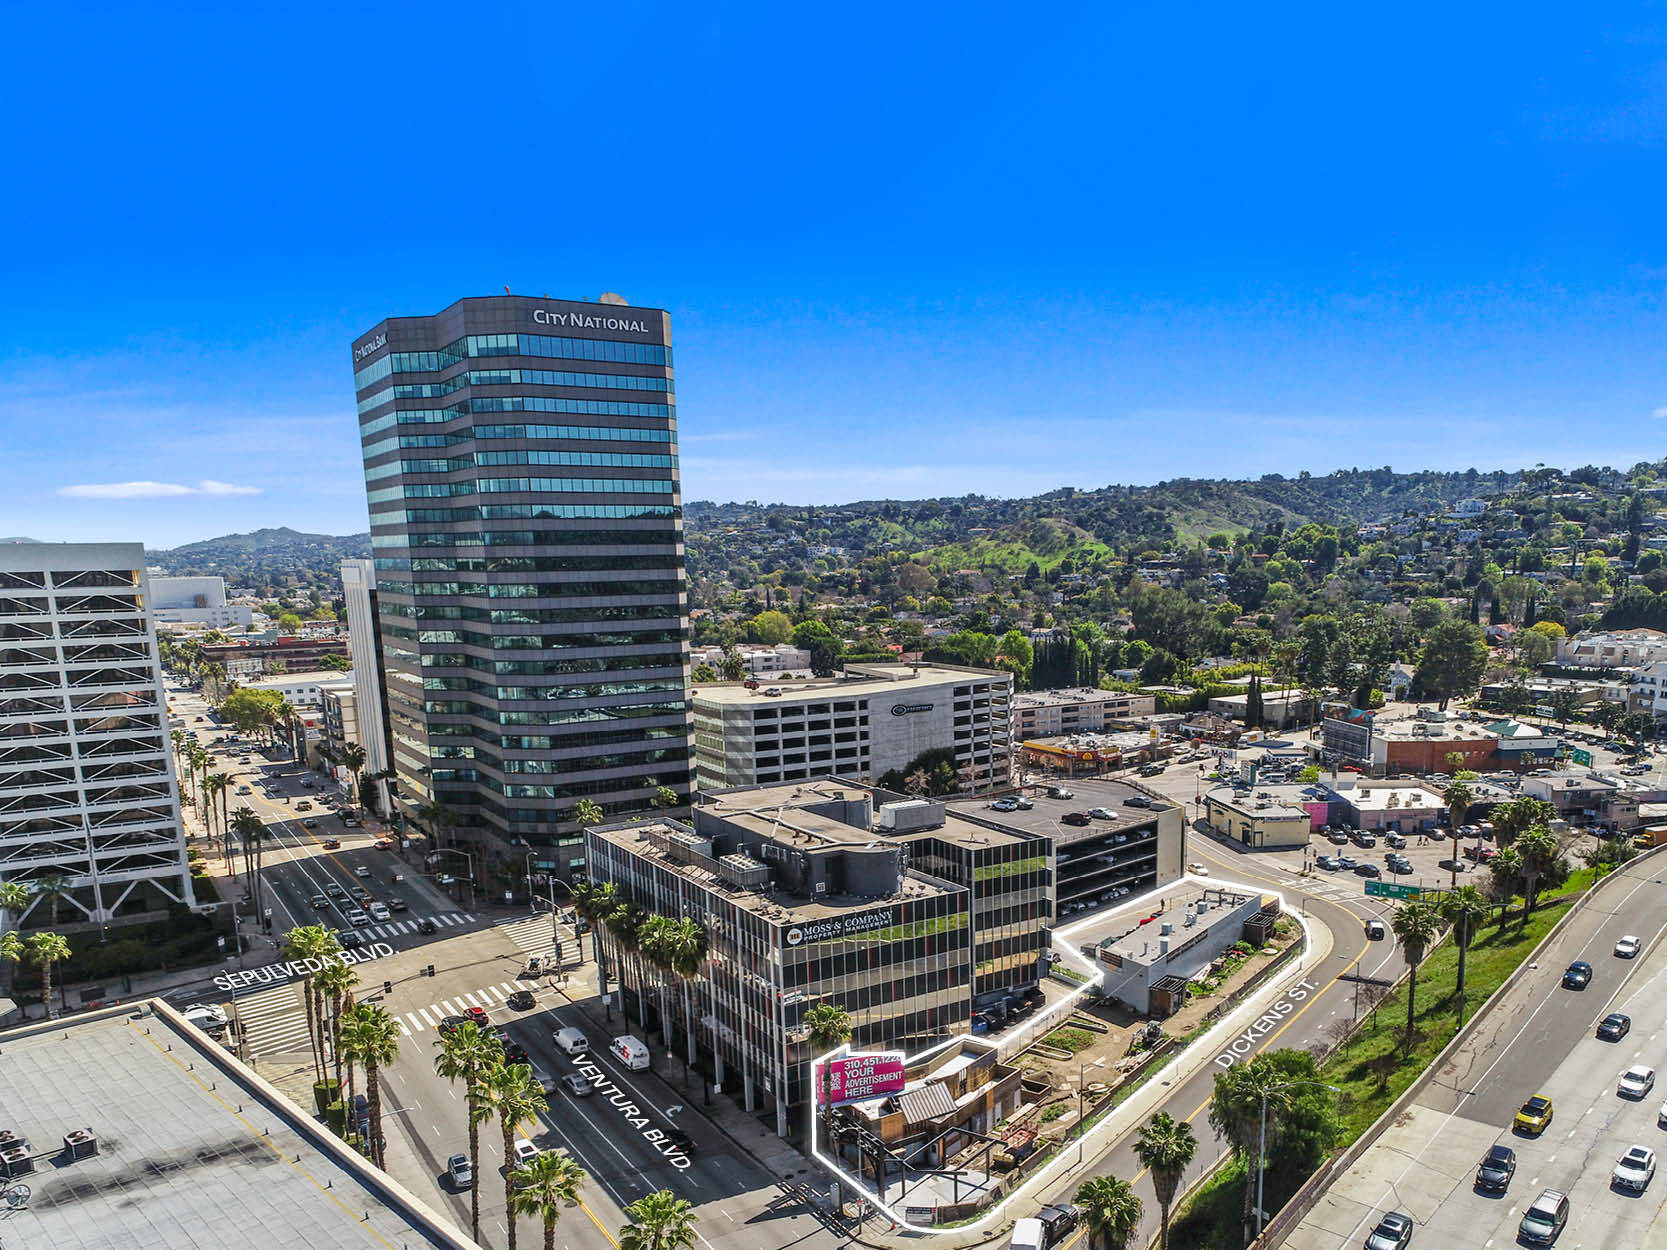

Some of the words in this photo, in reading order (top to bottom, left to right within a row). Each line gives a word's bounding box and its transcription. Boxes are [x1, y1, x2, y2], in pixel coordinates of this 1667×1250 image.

[570, 312, 649, 333] NATIONAL
[803, 923, 832, 936] MOSS
[844, 910, 893, 928] COMPANY
[803, 930, 841, 941] PROPERTY
[846, 918, 892, 932] MANAGEMENT
[844, 1066, 874, 1079] YOUR
[844, 1071, 903, 1089] ADVERTISEMENT
[844, 1085, 873, 1098] HERE
